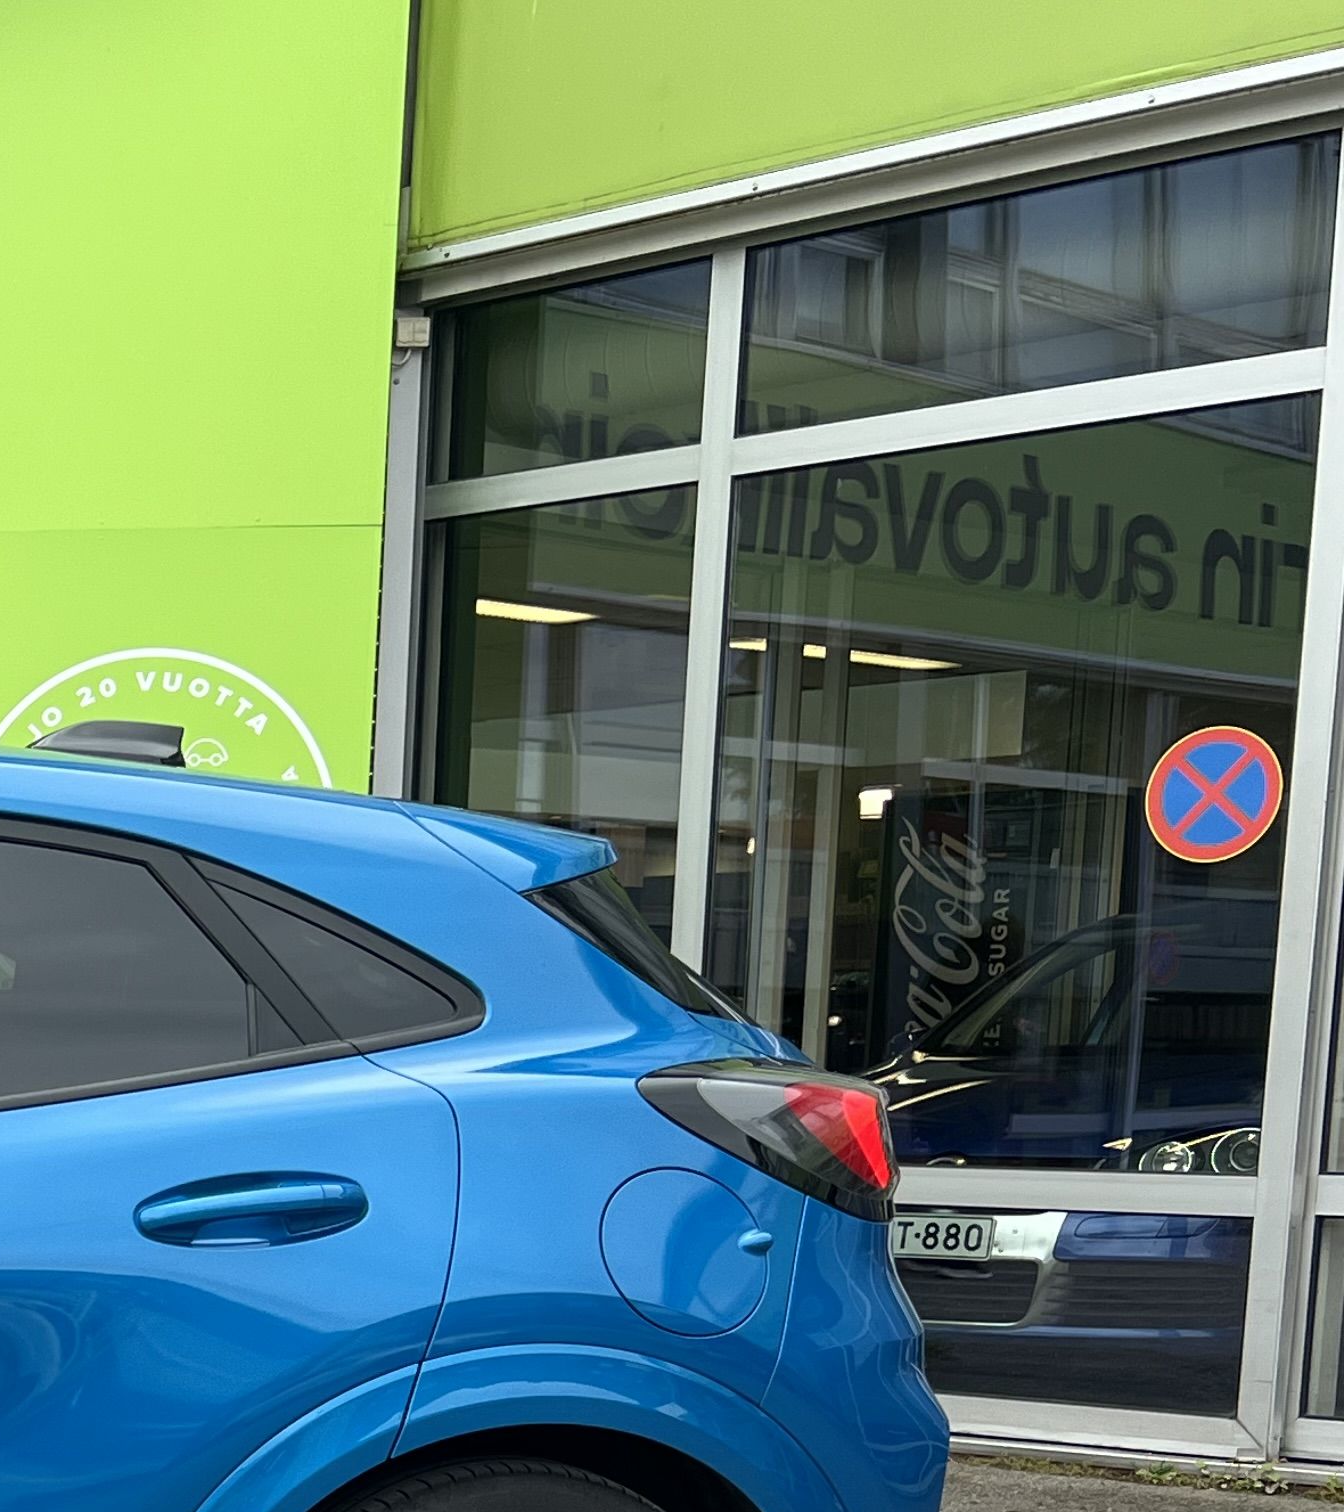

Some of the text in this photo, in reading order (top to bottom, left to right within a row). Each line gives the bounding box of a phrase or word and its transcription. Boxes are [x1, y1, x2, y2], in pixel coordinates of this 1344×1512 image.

[75, 677, 118, 708] 20
[135, 671, 269, 736] VUOTTA
[988, 888, 1011, 977] SUGAR
